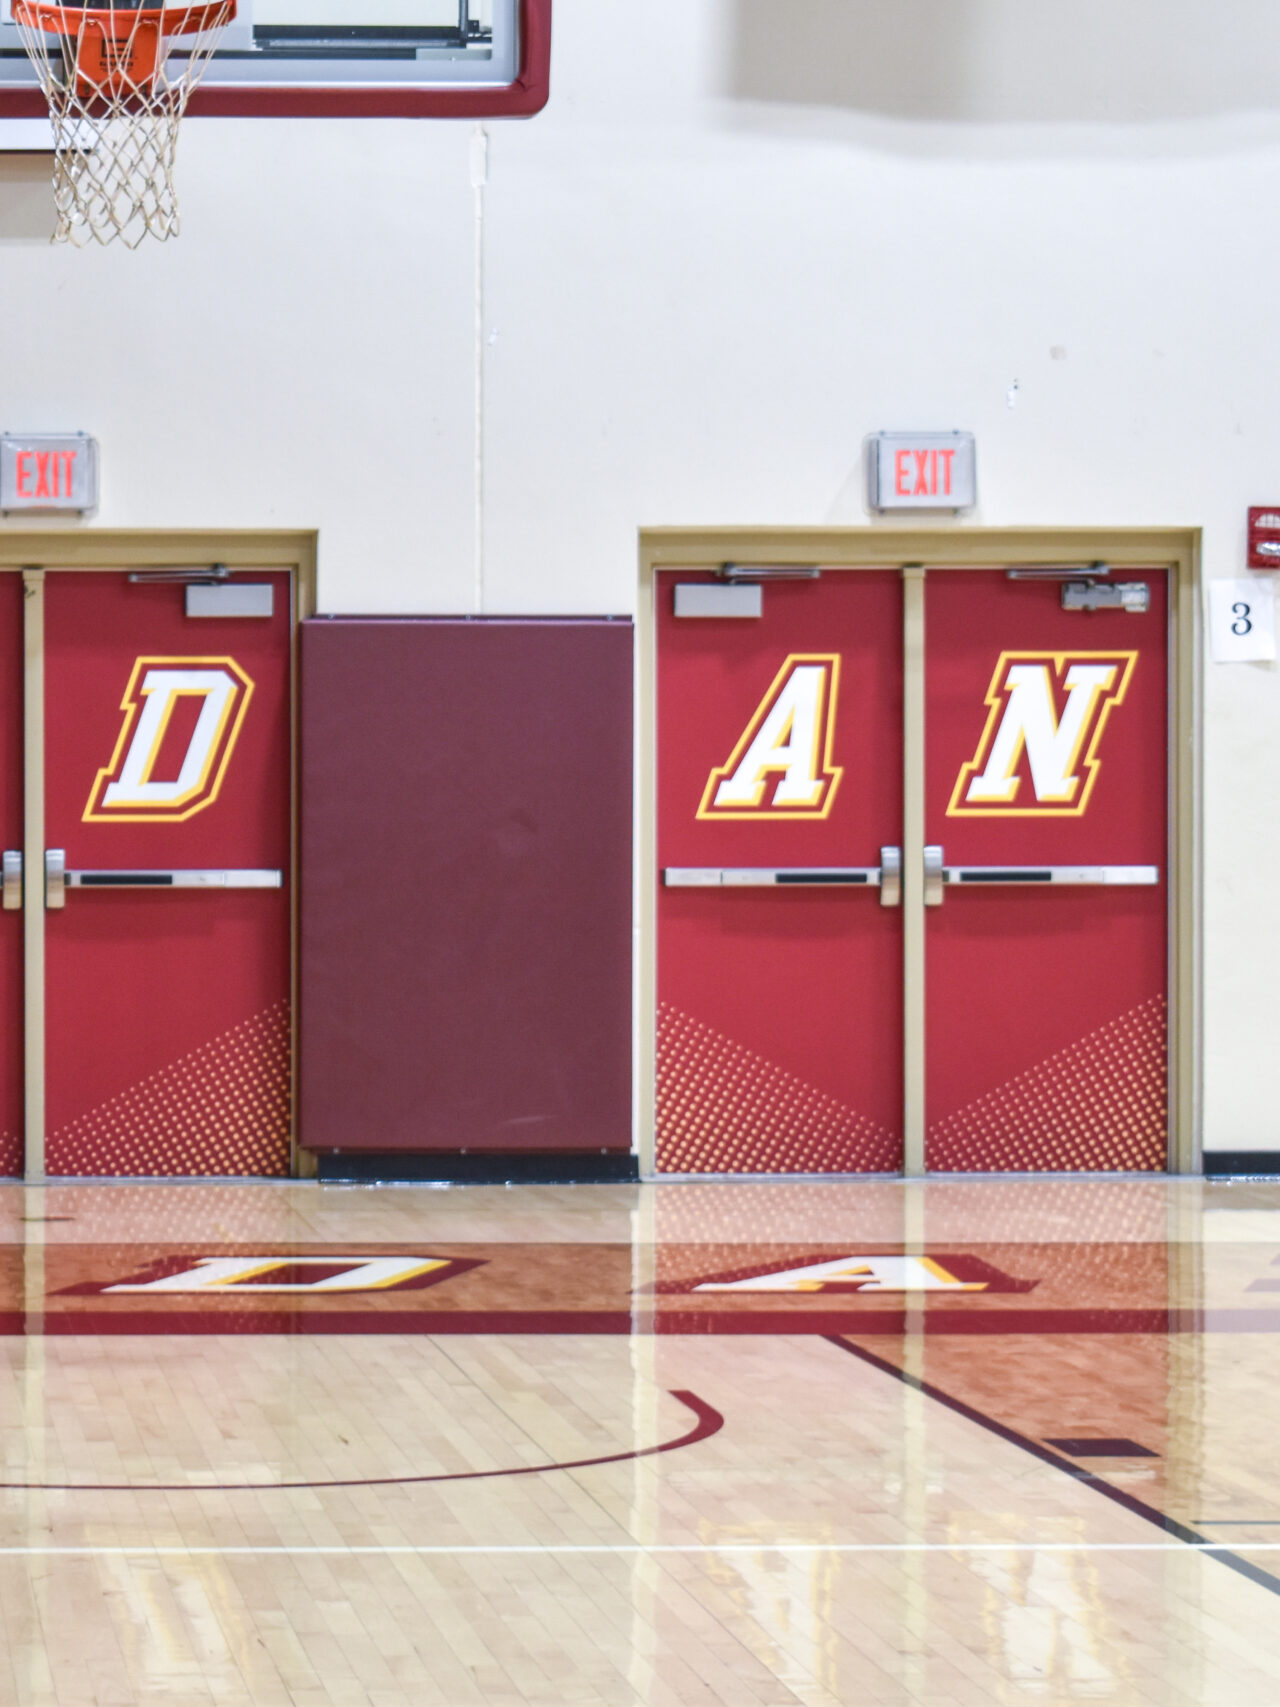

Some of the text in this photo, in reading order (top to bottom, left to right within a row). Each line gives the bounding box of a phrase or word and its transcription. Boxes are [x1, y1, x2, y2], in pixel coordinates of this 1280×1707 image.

[16, 450, 77, 498] EXIT
[895, 449, 955, 496] EXIT
[1231, 602, 1252, 636] 3
